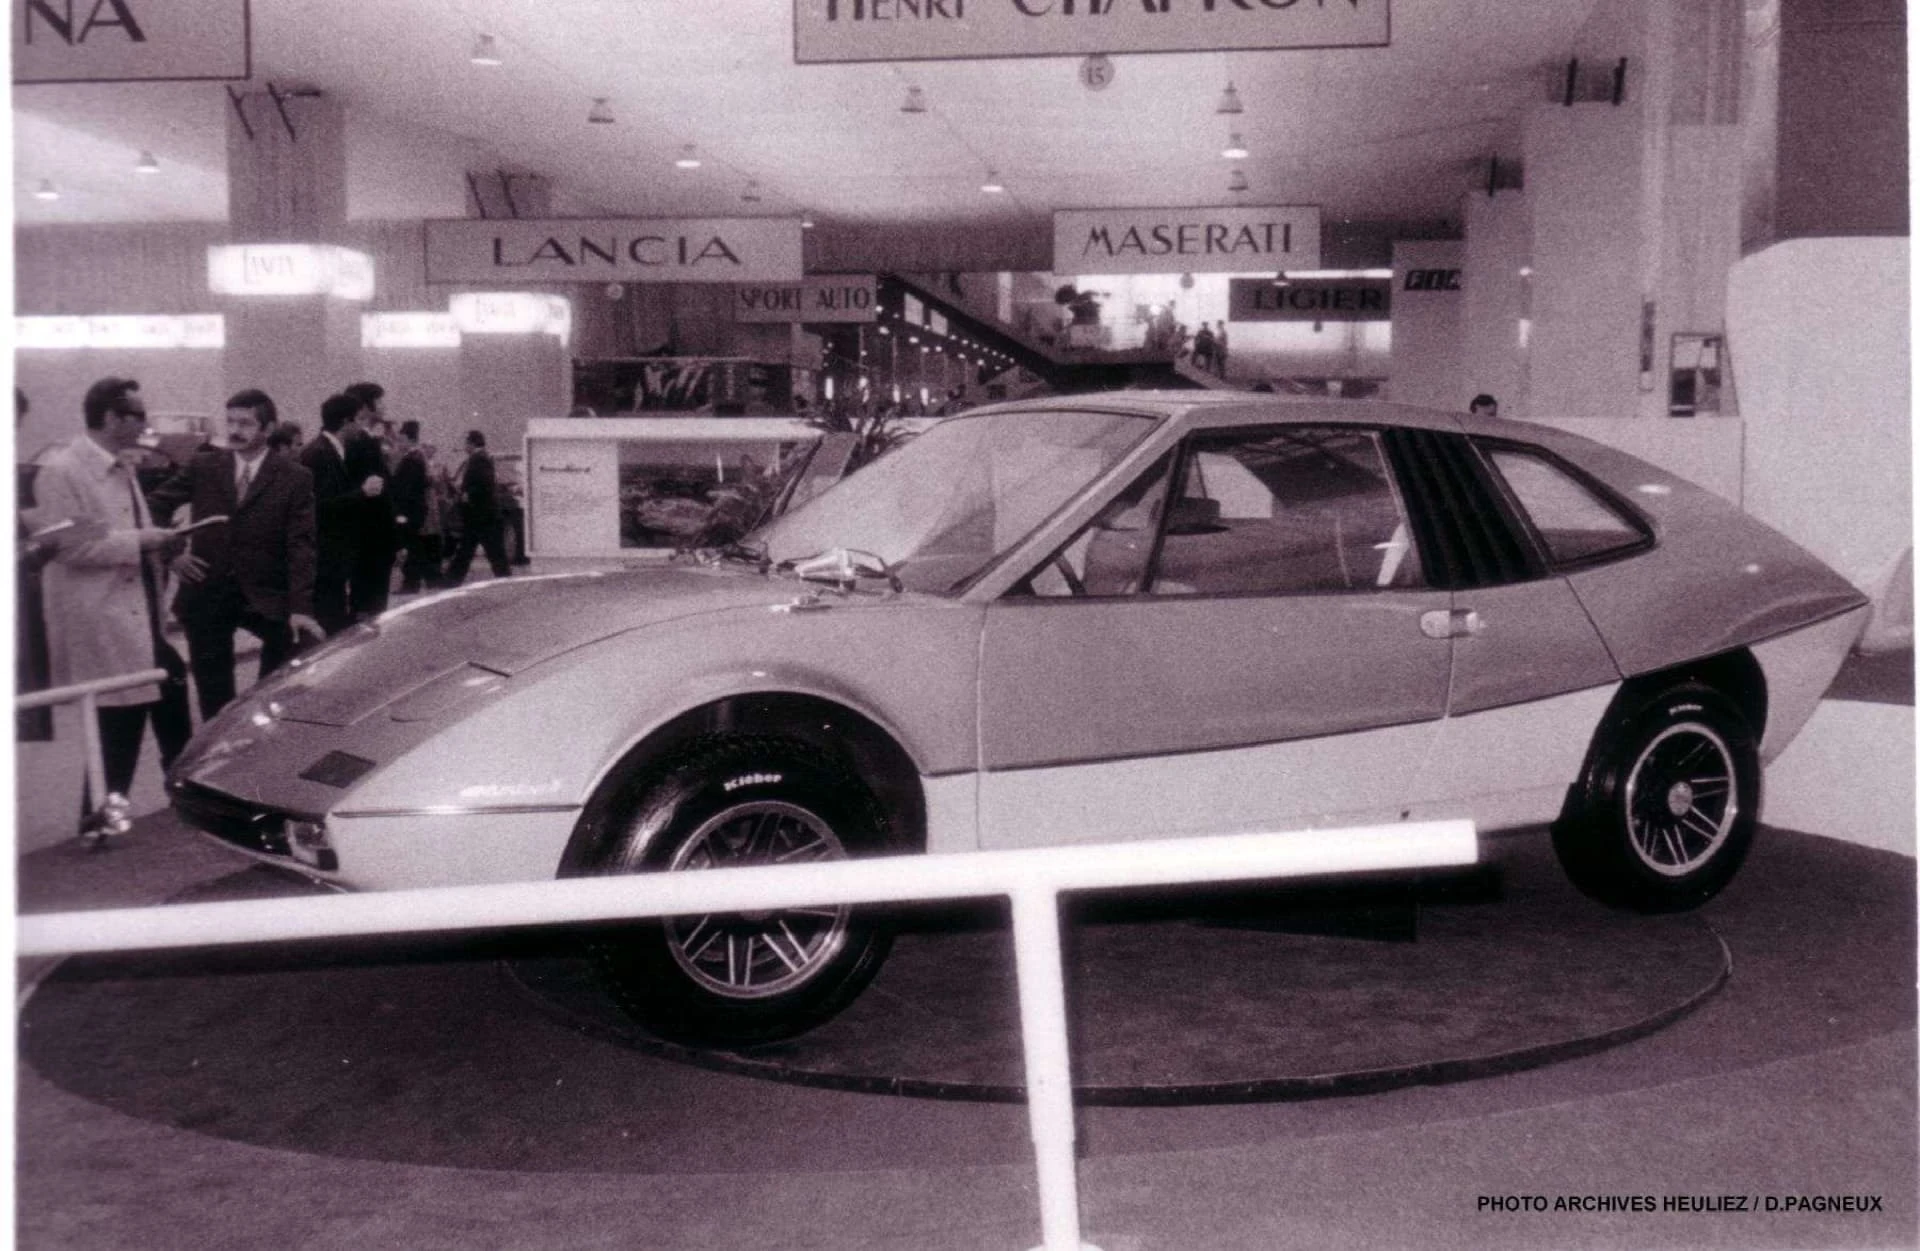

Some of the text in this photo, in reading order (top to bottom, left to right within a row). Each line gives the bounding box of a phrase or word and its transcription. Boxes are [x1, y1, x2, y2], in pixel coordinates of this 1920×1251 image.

[492, 235, 741, 266] LANCIA
[1082, 222, 1293, 257] MASERATI
[816, 285, 871, 310] AUTO
[1252, 287, 1384, 311] LIGIER
